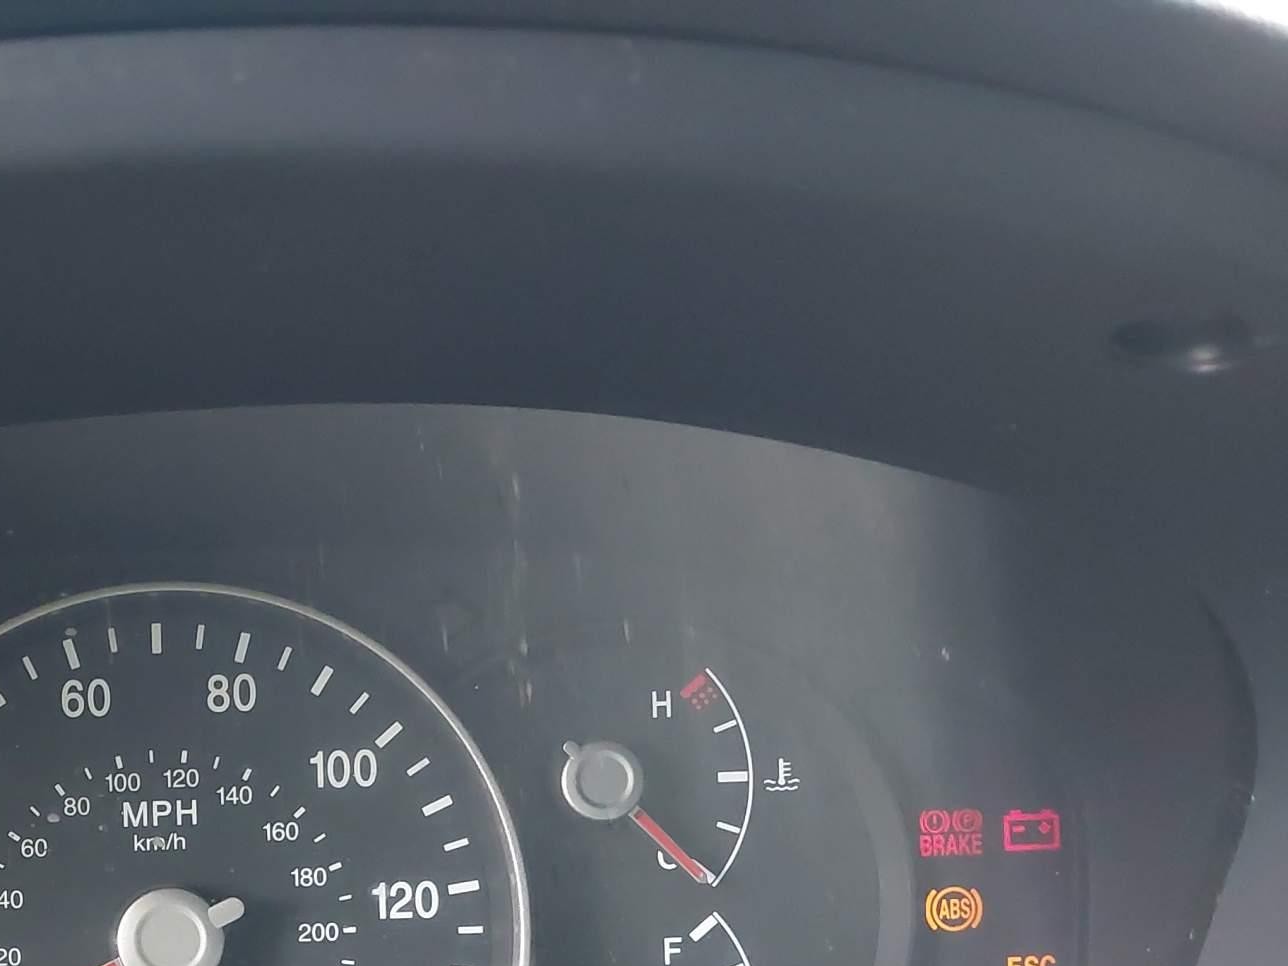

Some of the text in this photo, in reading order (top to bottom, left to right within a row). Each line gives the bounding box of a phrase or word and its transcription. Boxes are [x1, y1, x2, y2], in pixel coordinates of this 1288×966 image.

[62, 678, 111, 717] 60
[207, 674, 256, 712] 80
[651, 691, 672, 718] H
[163, 769, 199, 788] 120
[310, 749, 377, 788] 100
[105, 773, 141, 792] 100
[216, 786, 253, 805] 140
[63, 797, 90, 816] 80
[122, 800, 198, 827] MPH
[133, 833, 186, 851] km/h
[262, 822, 299, 841] 160
[20, 838, 48, 857] 60
[919, 834, 983, 857] BRAKE
[290, 868, 327, 887] 180
[372, 881, 439, 921] 120
[939, 898, 971, 920] ABS
[297, 922, 339, 943] 200
[664, 938, 682, 965] F
